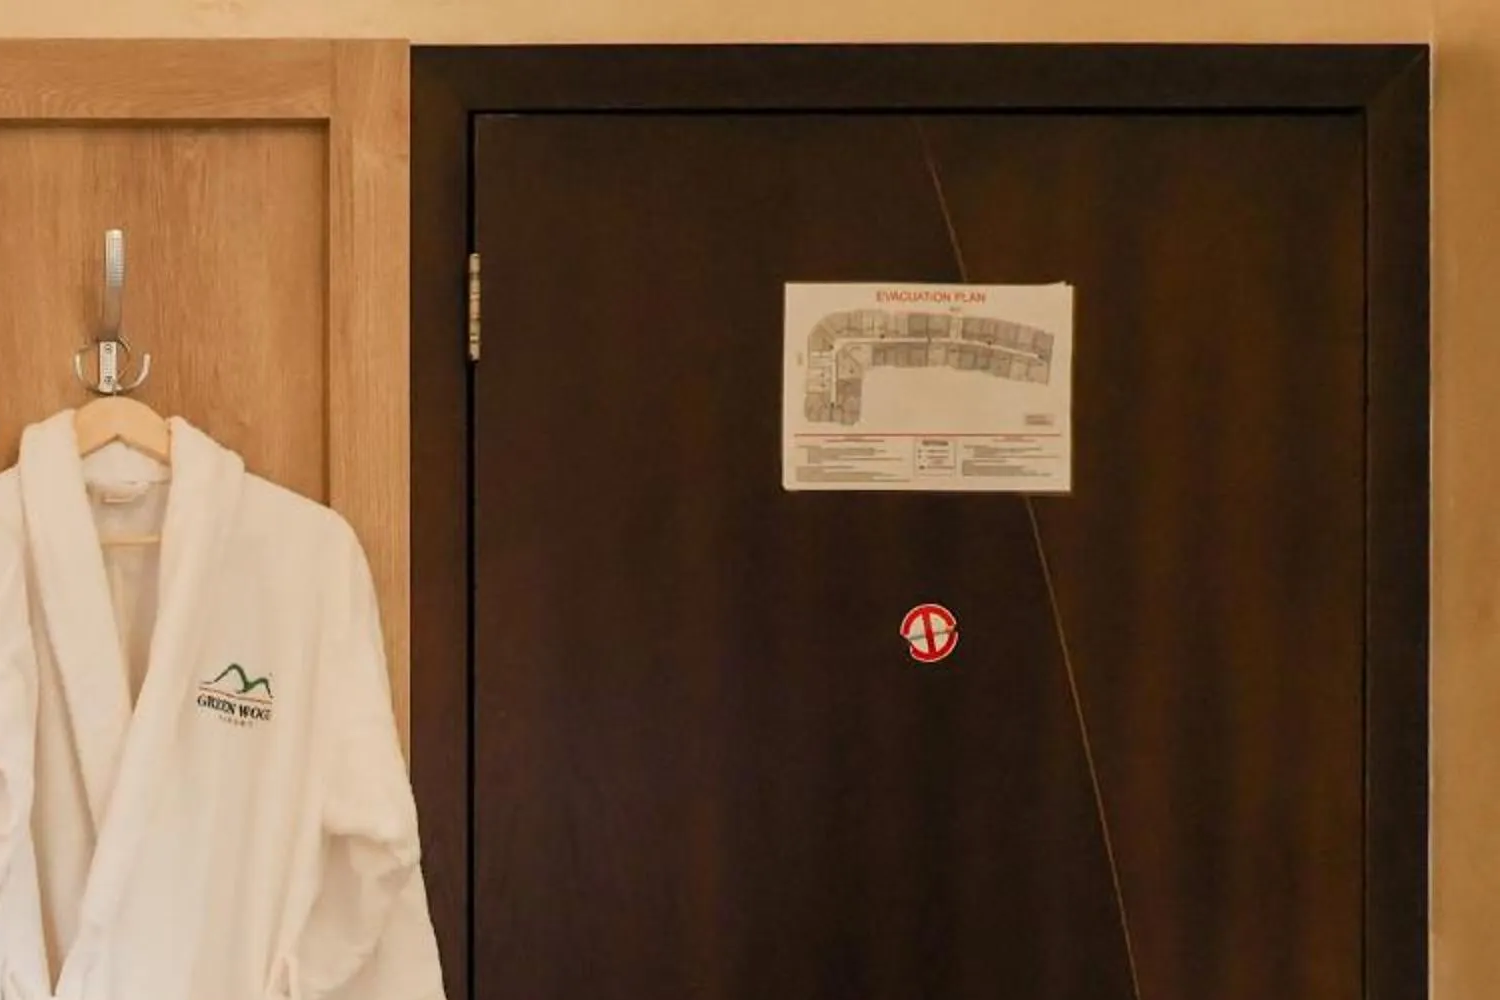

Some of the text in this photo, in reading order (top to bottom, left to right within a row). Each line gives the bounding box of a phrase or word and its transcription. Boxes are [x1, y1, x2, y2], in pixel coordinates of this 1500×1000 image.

[876, 290, 986, 304] EVACUATION PLAN
[197, 695, 237, 715] GREEN
